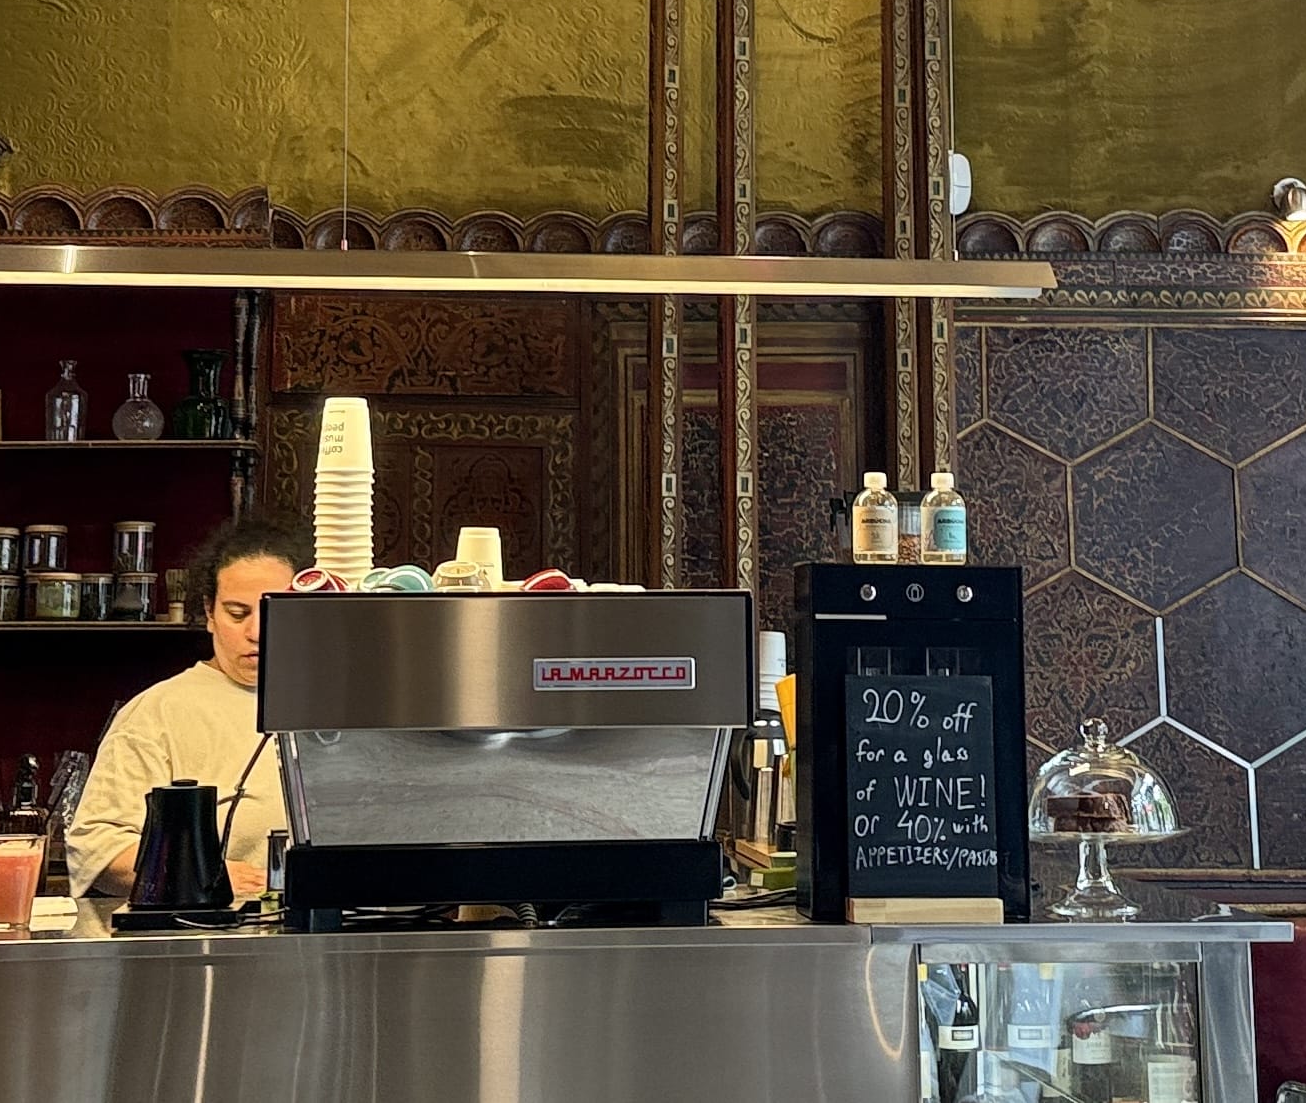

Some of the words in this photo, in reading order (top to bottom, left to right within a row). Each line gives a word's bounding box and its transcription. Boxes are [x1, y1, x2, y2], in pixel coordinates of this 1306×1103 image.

[862, 689, 930, 729] 20%
[942, 702, 978, 733] off
[856, 739, 885, 762] for
[893, 749, 908, 762] a
[923, 736, 969, 769] glass
[856, 779, 877, 801] of
[894, 774, 986, 810] WINE!
[897, 810, 947, 844] 40%
[952, 813, 989, 834] with
